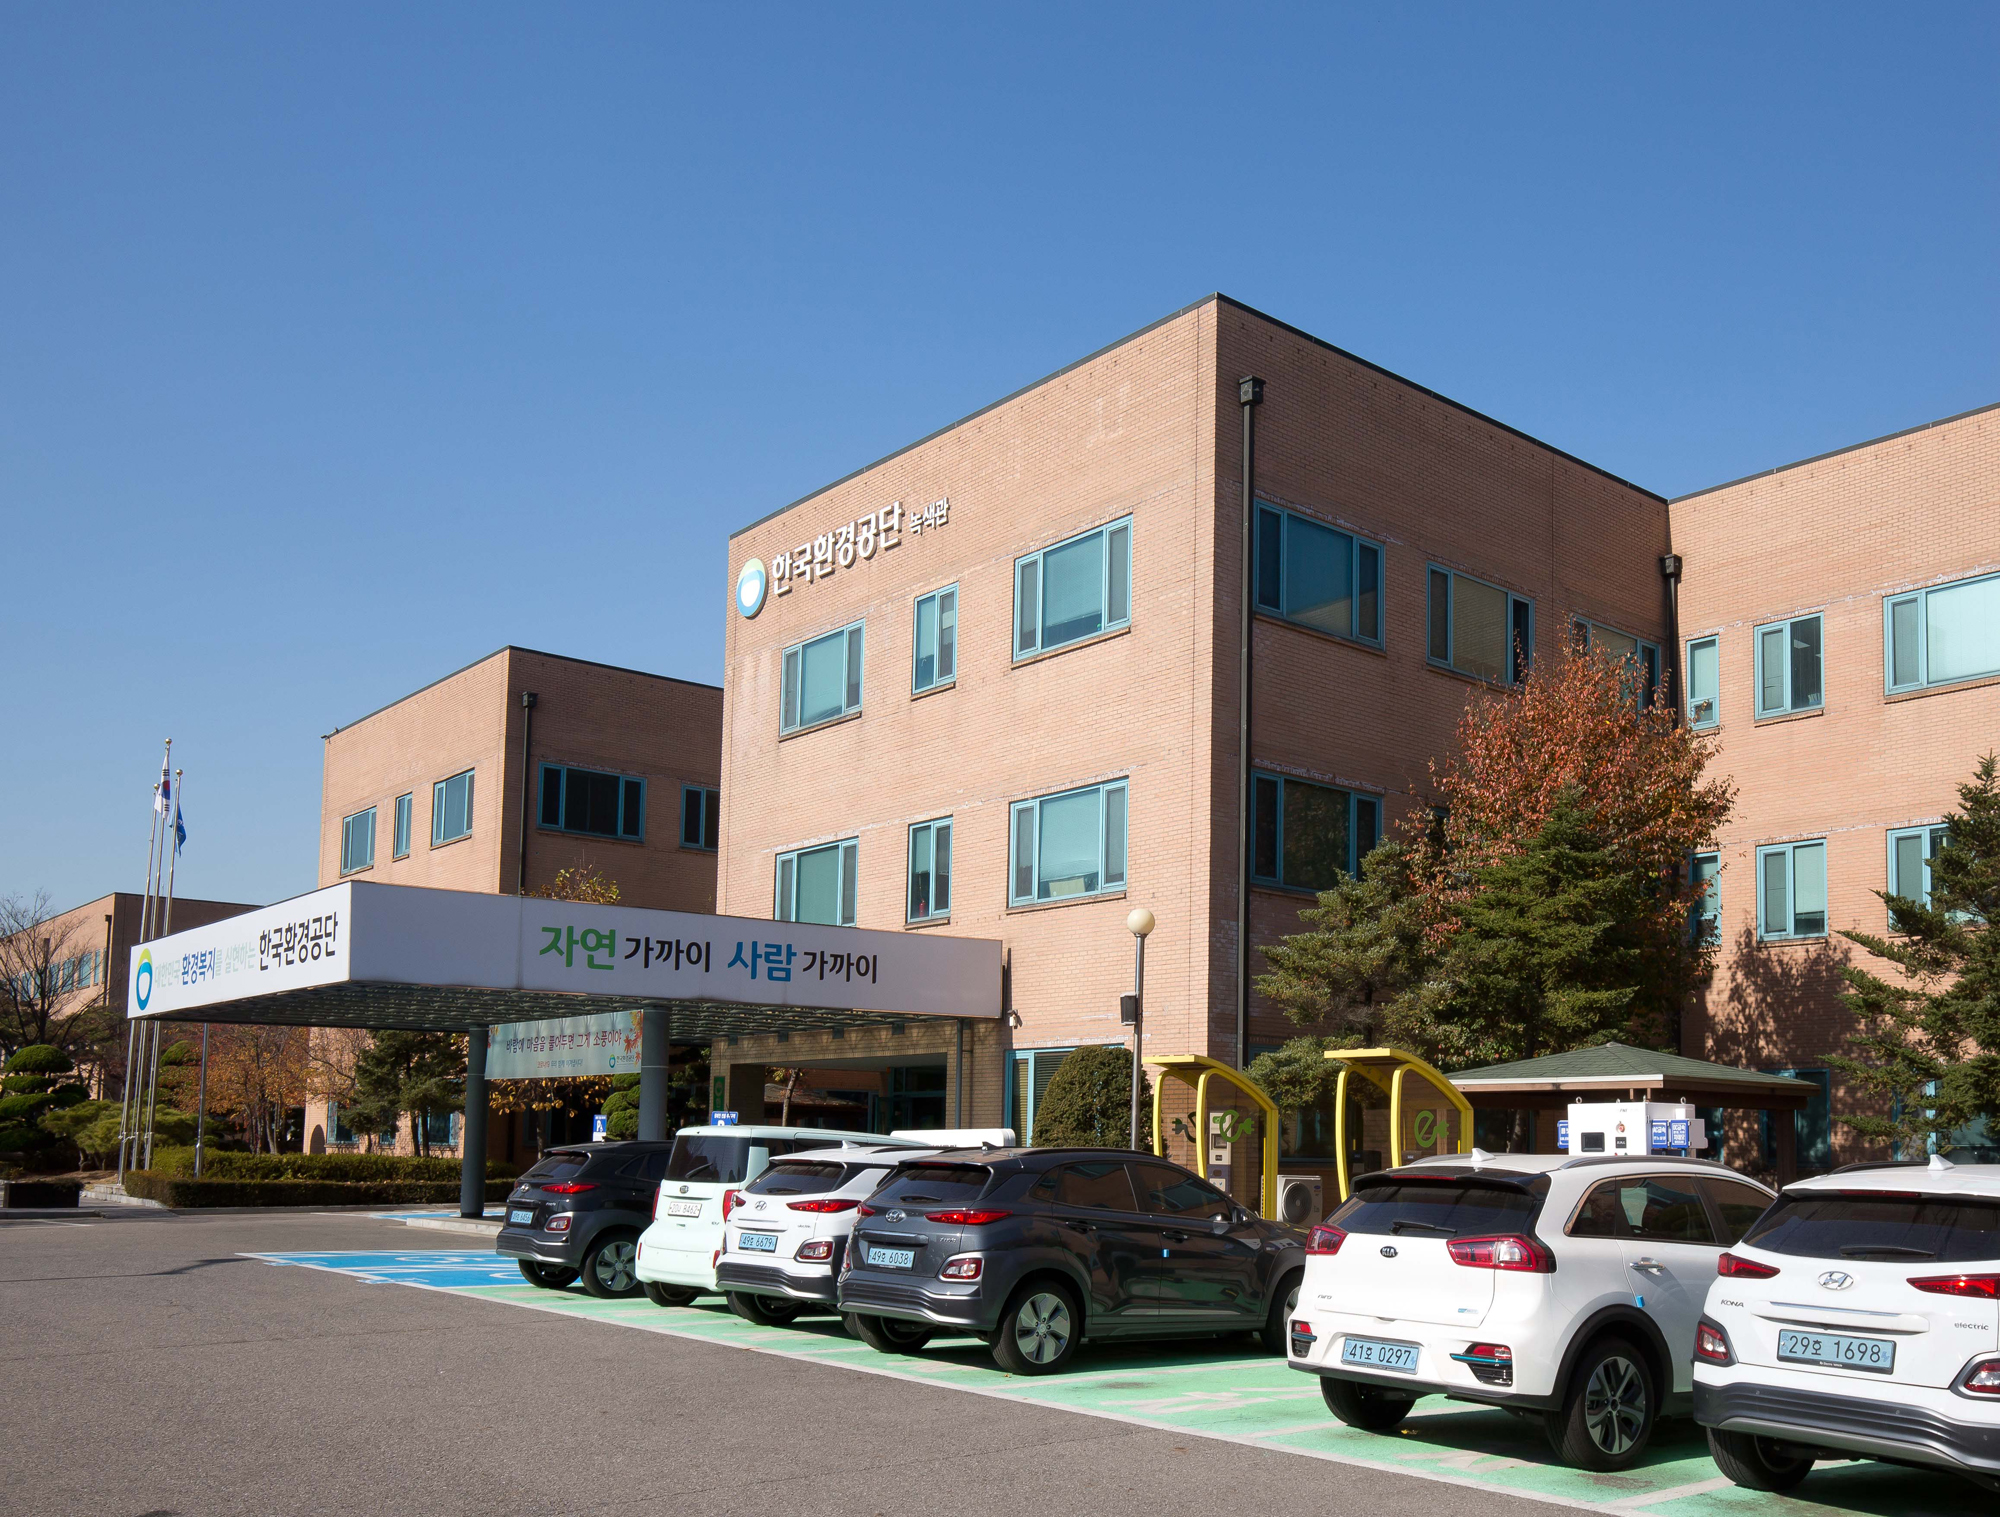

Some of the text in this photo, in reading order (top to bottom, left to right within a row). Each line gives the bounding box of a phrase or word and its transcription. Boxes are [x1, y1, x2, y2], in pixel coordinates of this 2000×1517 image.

[771, 497, 951, 598] 한국환경공단 녹색관
[155, 959, 181, 989] 대한민국
[225, 941, 256, 973] 실현하는
[259, 911, 339, 972] 한국환경공단
[539, 925, 878, 984] 자연 가까이 사람 가까이
[506, 1028, 622, 1054] 바람에 마음을 풀어두면 그게 소풍이야
[755, 1237, 773, 1248] 6679
[1381, 1246, 1397, 1257] KIA
[888, 1252, 909, 1265] 6038
[1720, 1299, 1744, 1308] KONA
[1954, 1321, 1989, 1331] electric
[1348, 1343, 1412, 1366] 41호 0297
[1788, 1334, 1881, 1364] 29호 1698
